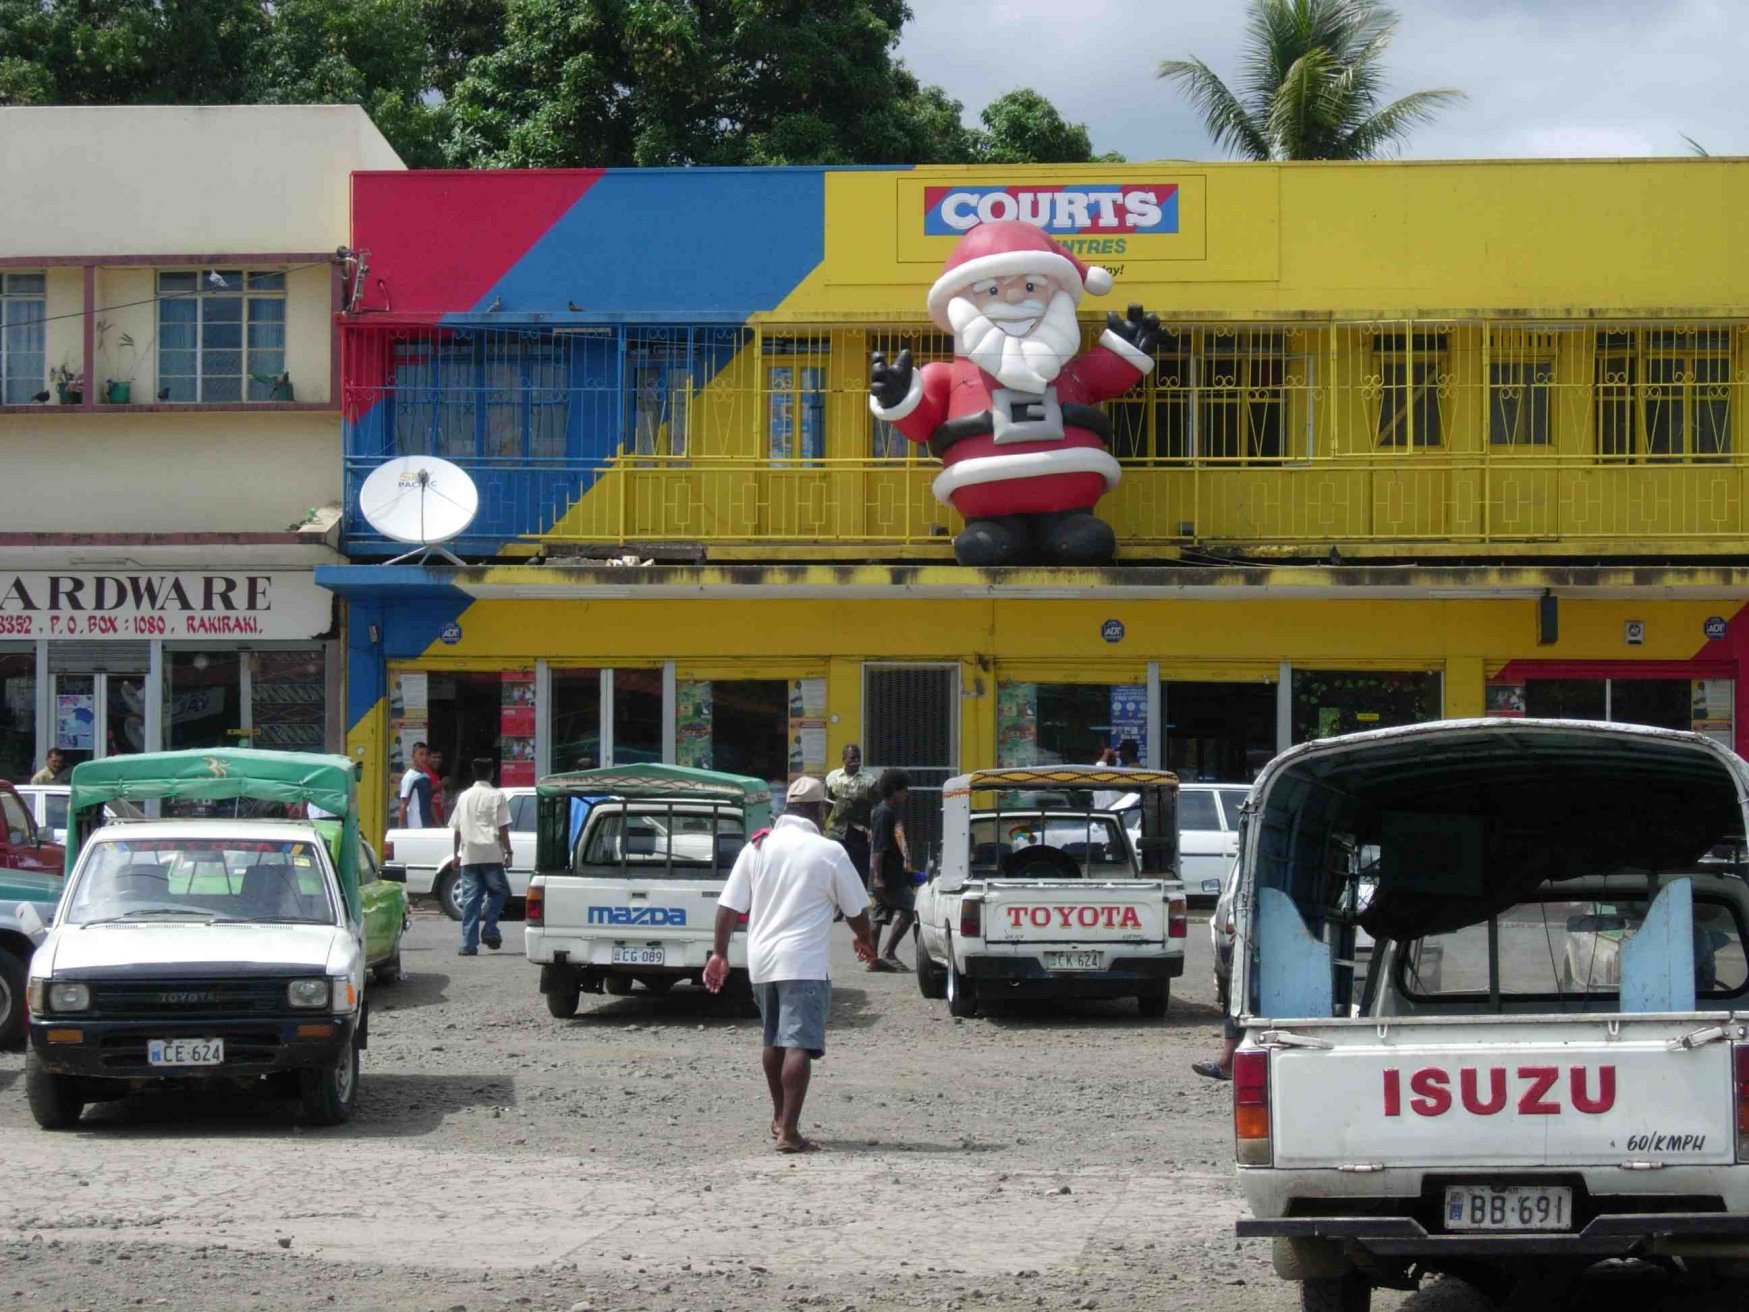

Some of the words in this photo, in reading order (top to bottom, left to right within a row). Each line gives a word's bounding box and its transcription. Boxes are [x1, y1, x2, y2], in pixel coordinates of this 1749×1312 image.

[941, 191, 1162, 230] COURTS
[1007, 906, 1143, 929] TOYOTA
[1383, 1065, 1617, 1117] ISUZU
